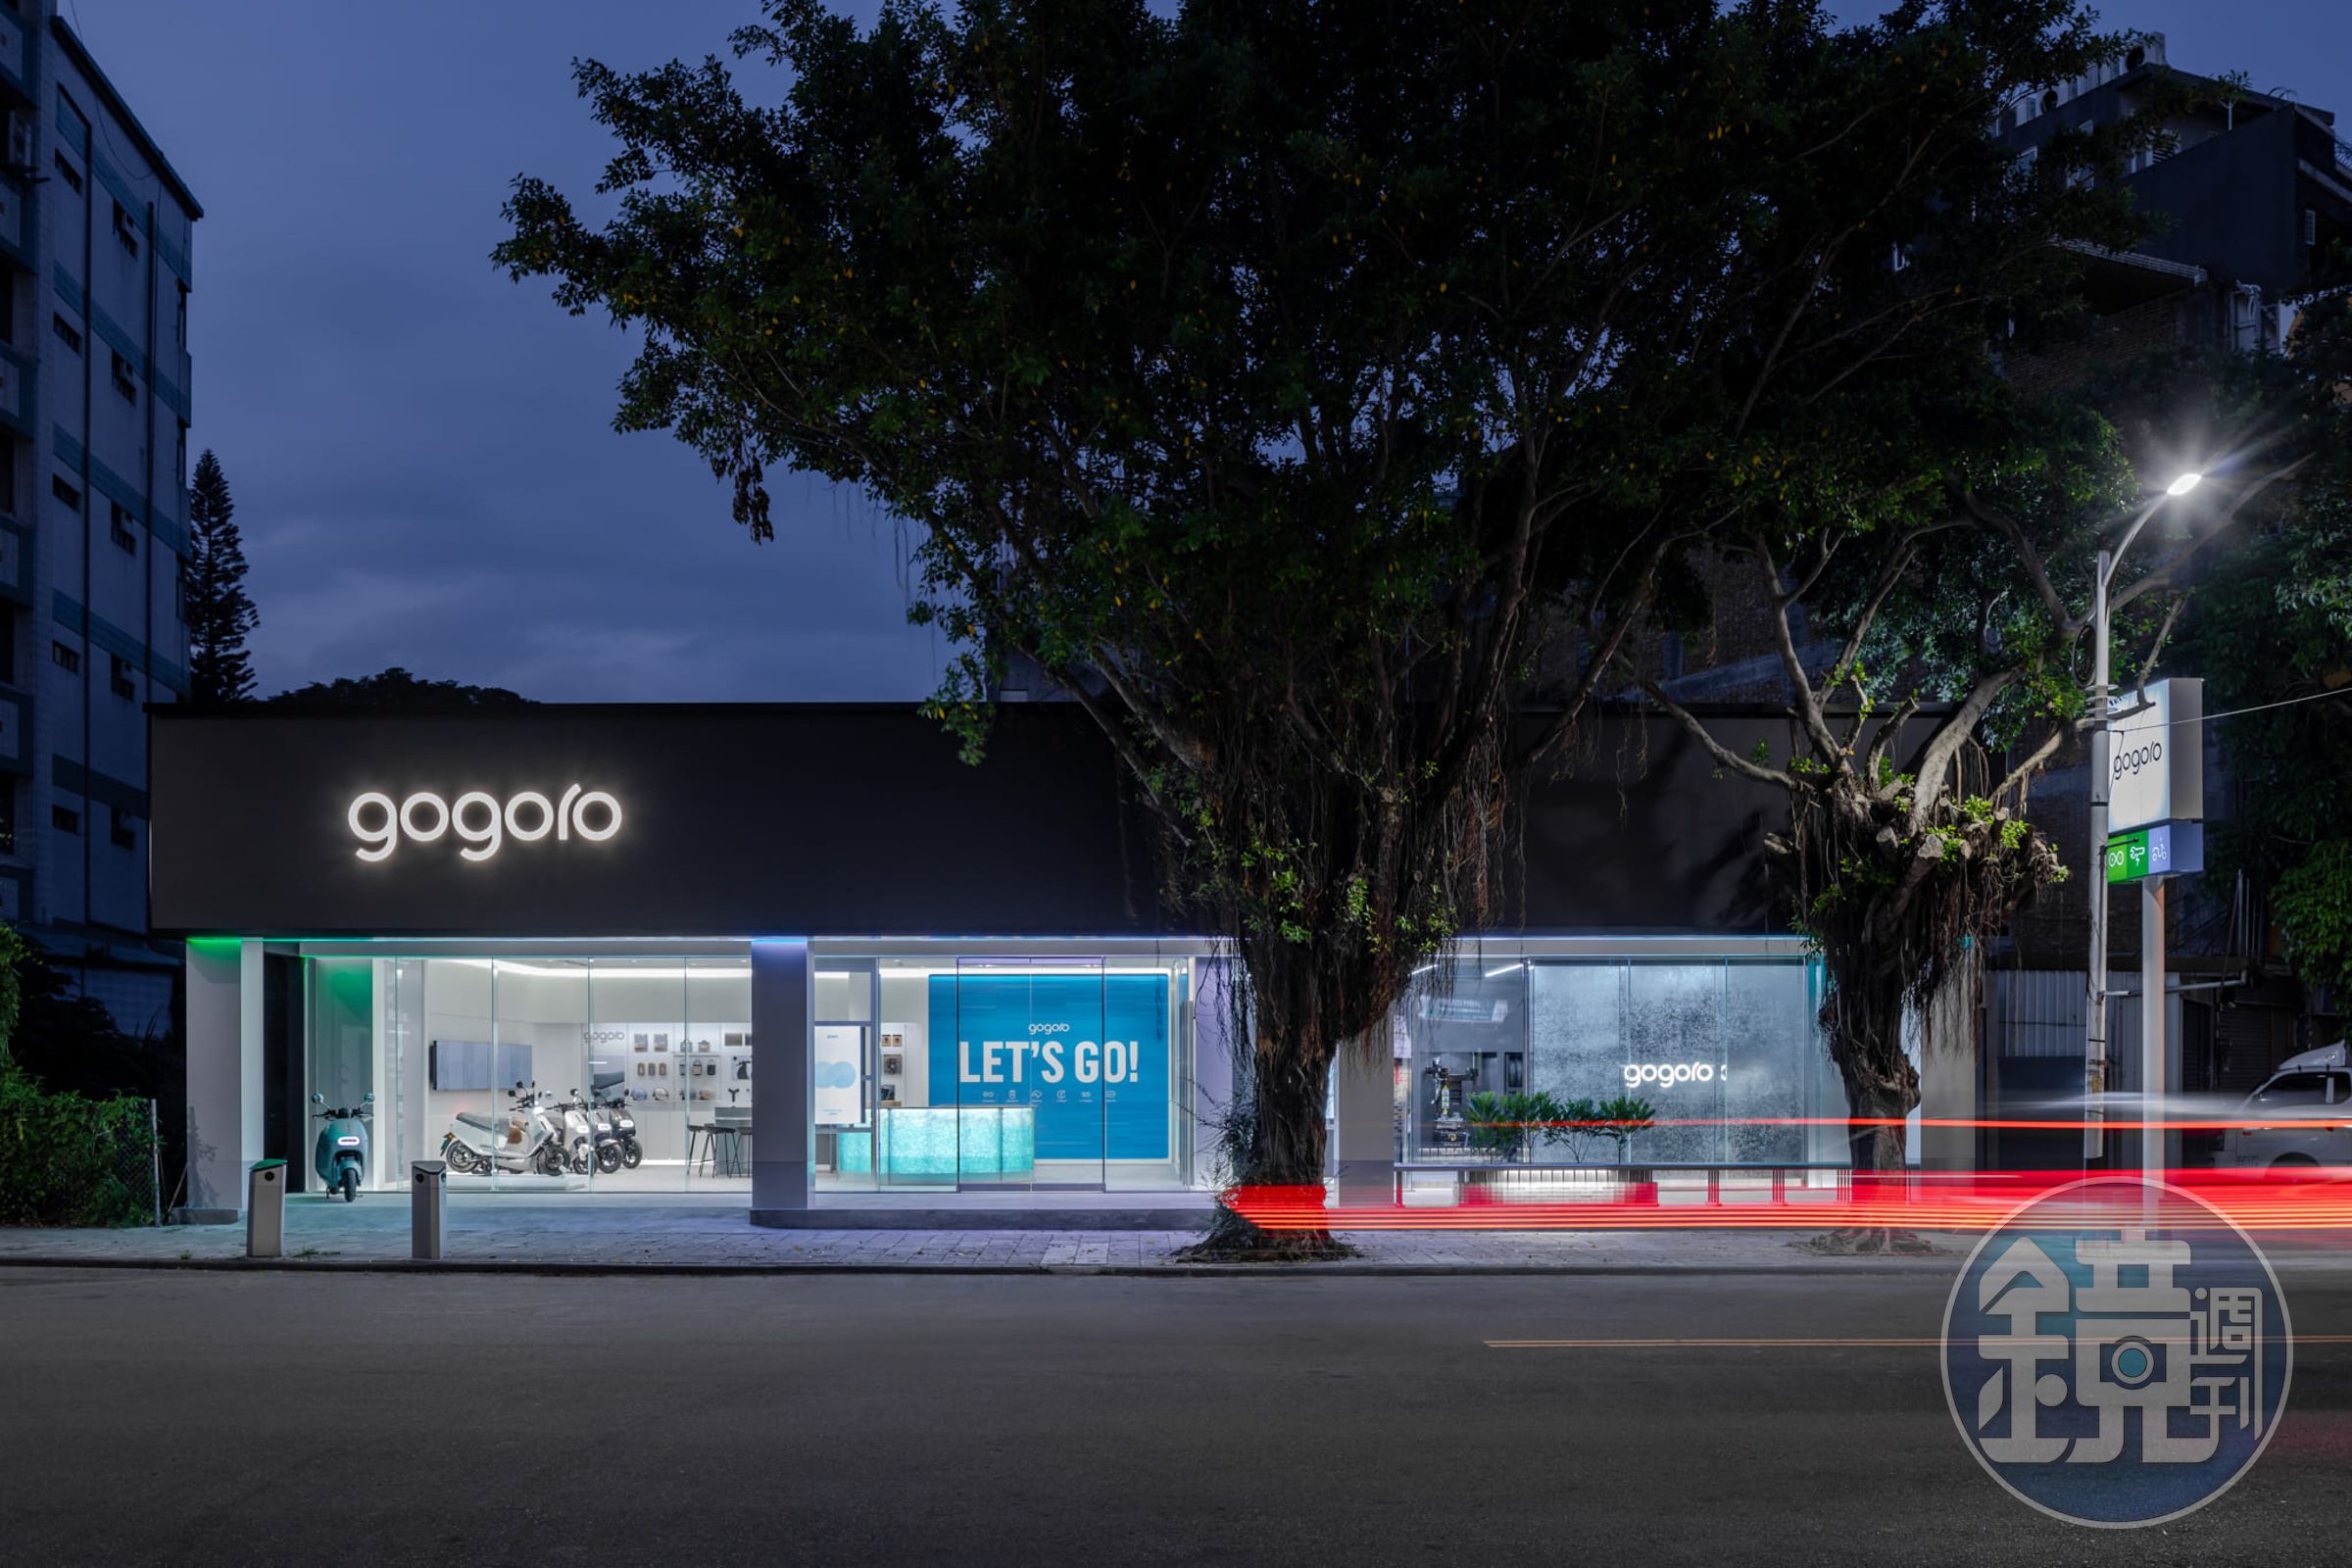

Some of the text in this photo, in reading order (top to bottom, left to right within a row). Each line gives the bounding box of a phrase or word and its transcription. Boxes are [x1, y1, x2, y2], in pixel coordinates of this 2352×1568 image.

[2114, 741, 2162, 780] gogoro
[348, 783, 622, 861] gogoro
[1028, 1022, 1070, 1035] gogoro
[1074, 1041, 1139, 1084] GO!
[1624, 1061, 1714, 1088] gogoro
